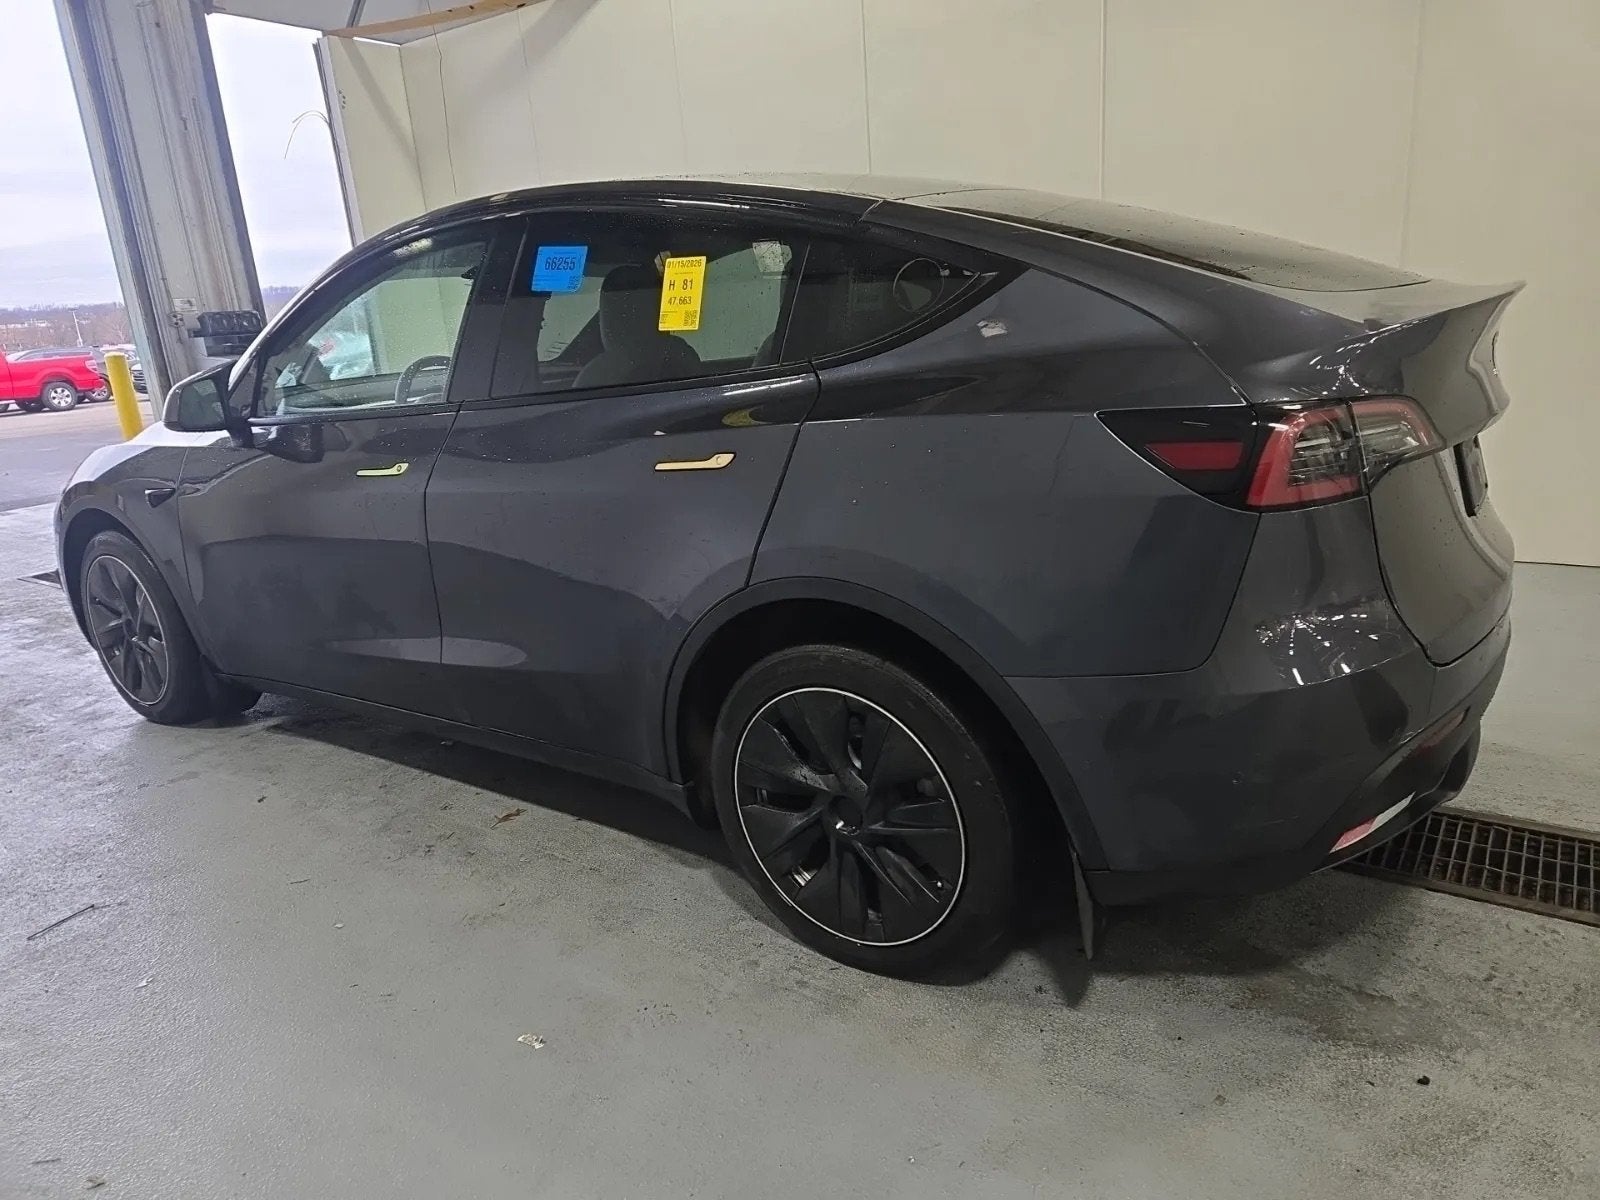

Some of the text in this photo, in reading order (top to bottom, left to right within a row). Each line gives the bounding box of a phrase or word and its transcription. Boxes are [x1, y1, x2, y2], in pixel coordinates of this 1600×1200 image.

[545, 256, 576, 271] 66255
[667, 258, 702, 269] 01/15/2026
[669, 278, 693, 291] H 81
